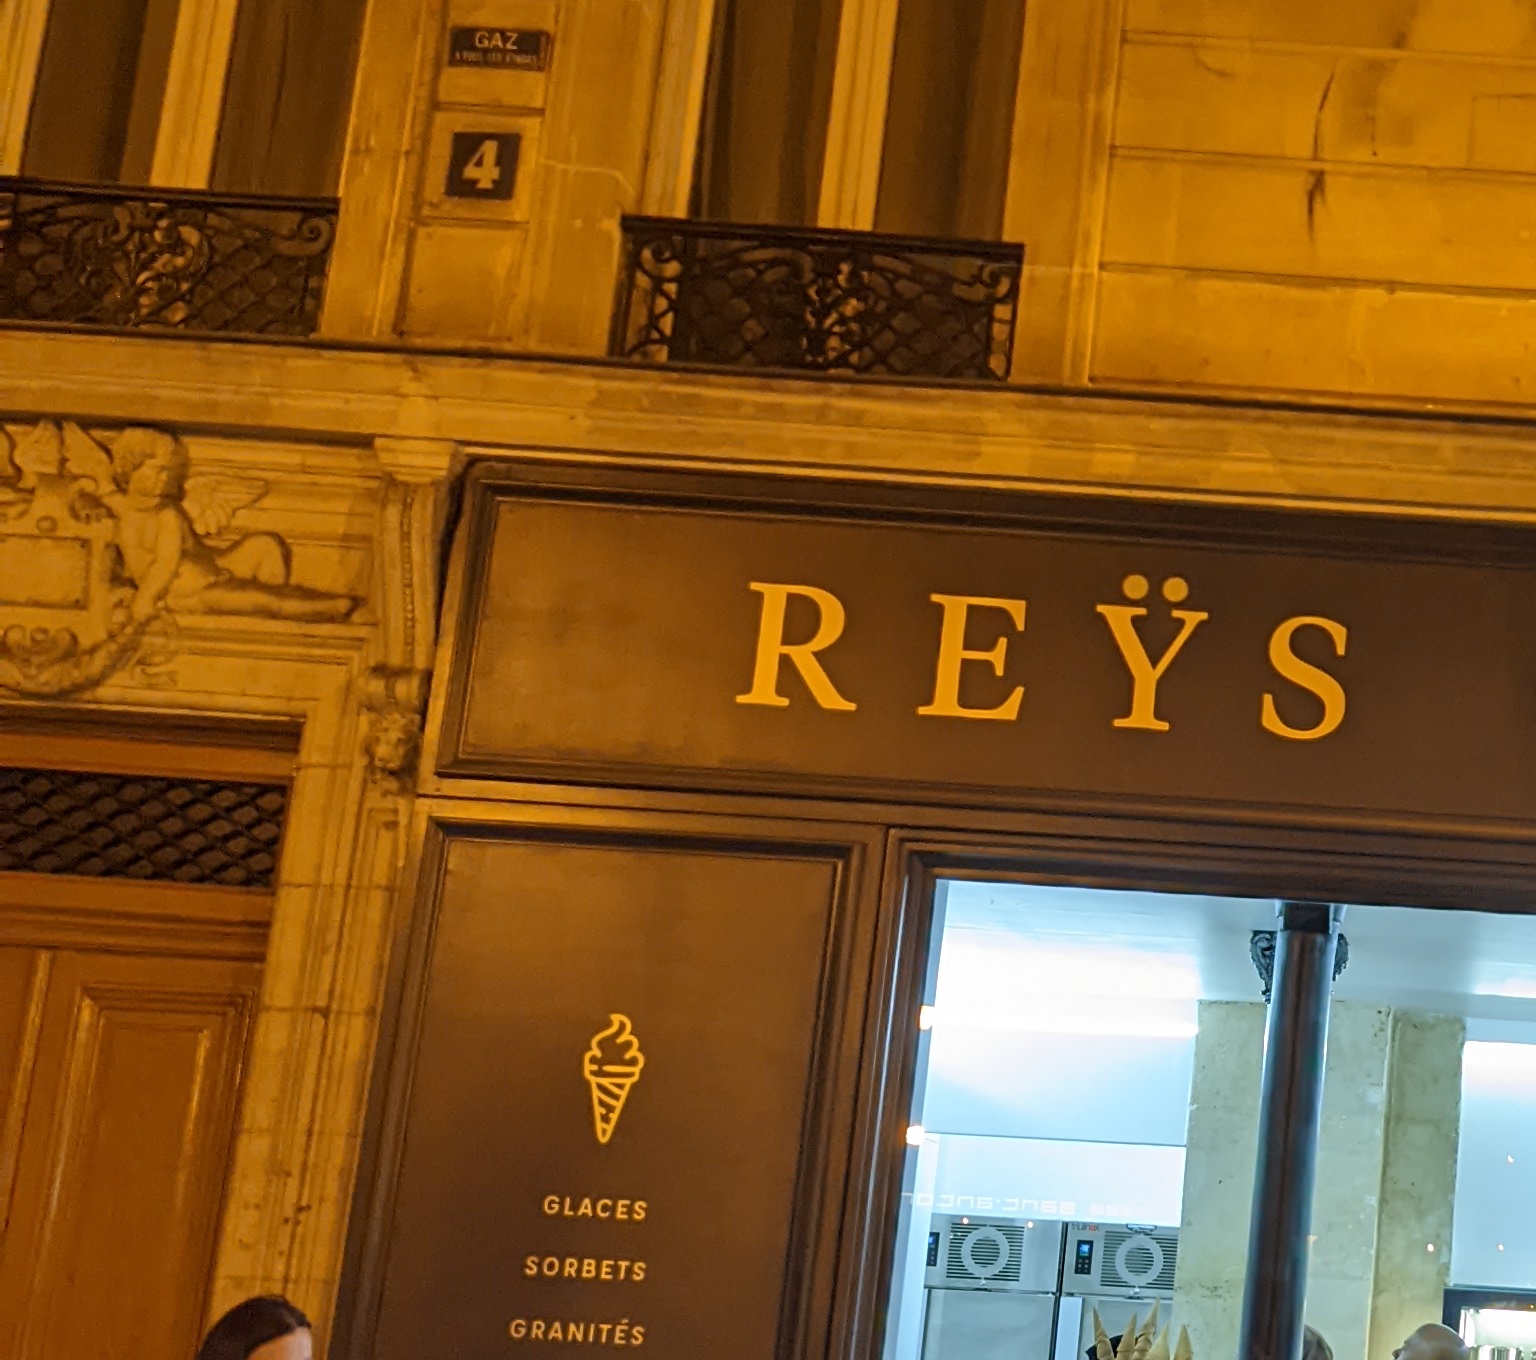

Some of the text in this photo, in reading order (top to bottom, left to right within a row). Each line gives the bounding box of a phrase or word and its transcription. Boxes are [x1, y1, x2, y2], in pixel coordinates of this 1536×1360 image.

[475, 30, 519, 50] GAZ
[462, 139, 501, 189] 4
[734, 574, 1347, 740] REŸS
[543, 1195, 648, 1221] GLACES
[524, 1256, 647, 1281] SORBETS
[509, 1318, 645, 1346] GRANITÉS
